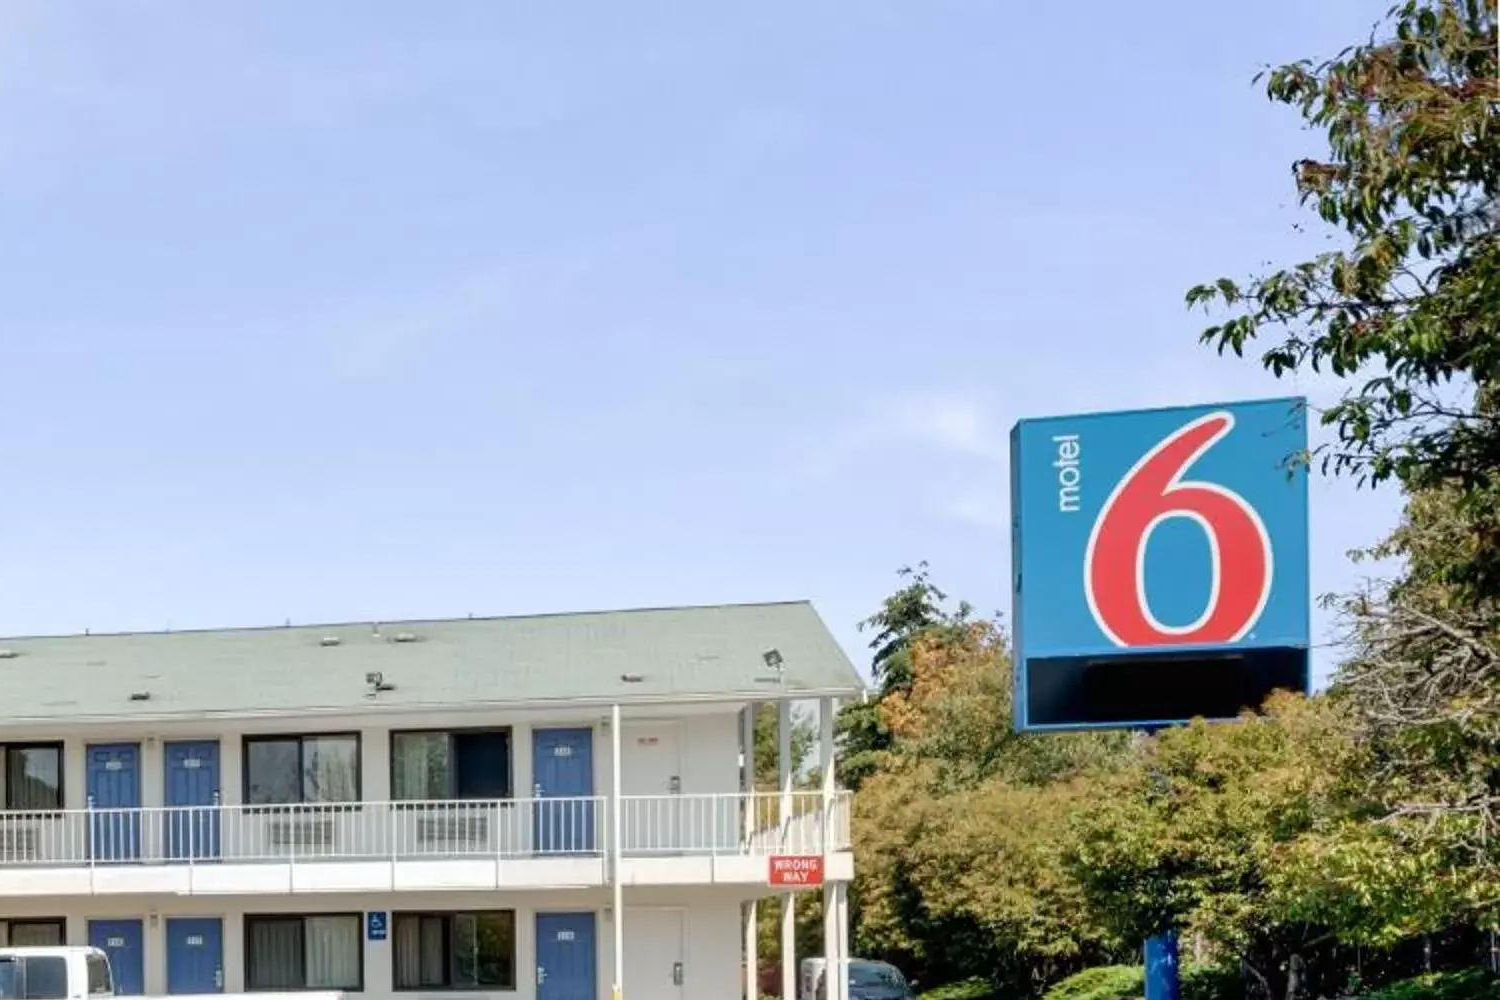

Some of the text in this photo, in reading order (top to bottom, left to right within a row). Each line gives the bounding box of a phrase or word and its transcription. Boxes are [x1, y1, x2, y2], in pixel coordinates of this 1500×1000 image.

[1052, 434, 1080, 512] motel
[1083, 410, 1274, 647] 6
[774, 859, 818, 871] WRONG
[783, 871, 808, 881] WAY
